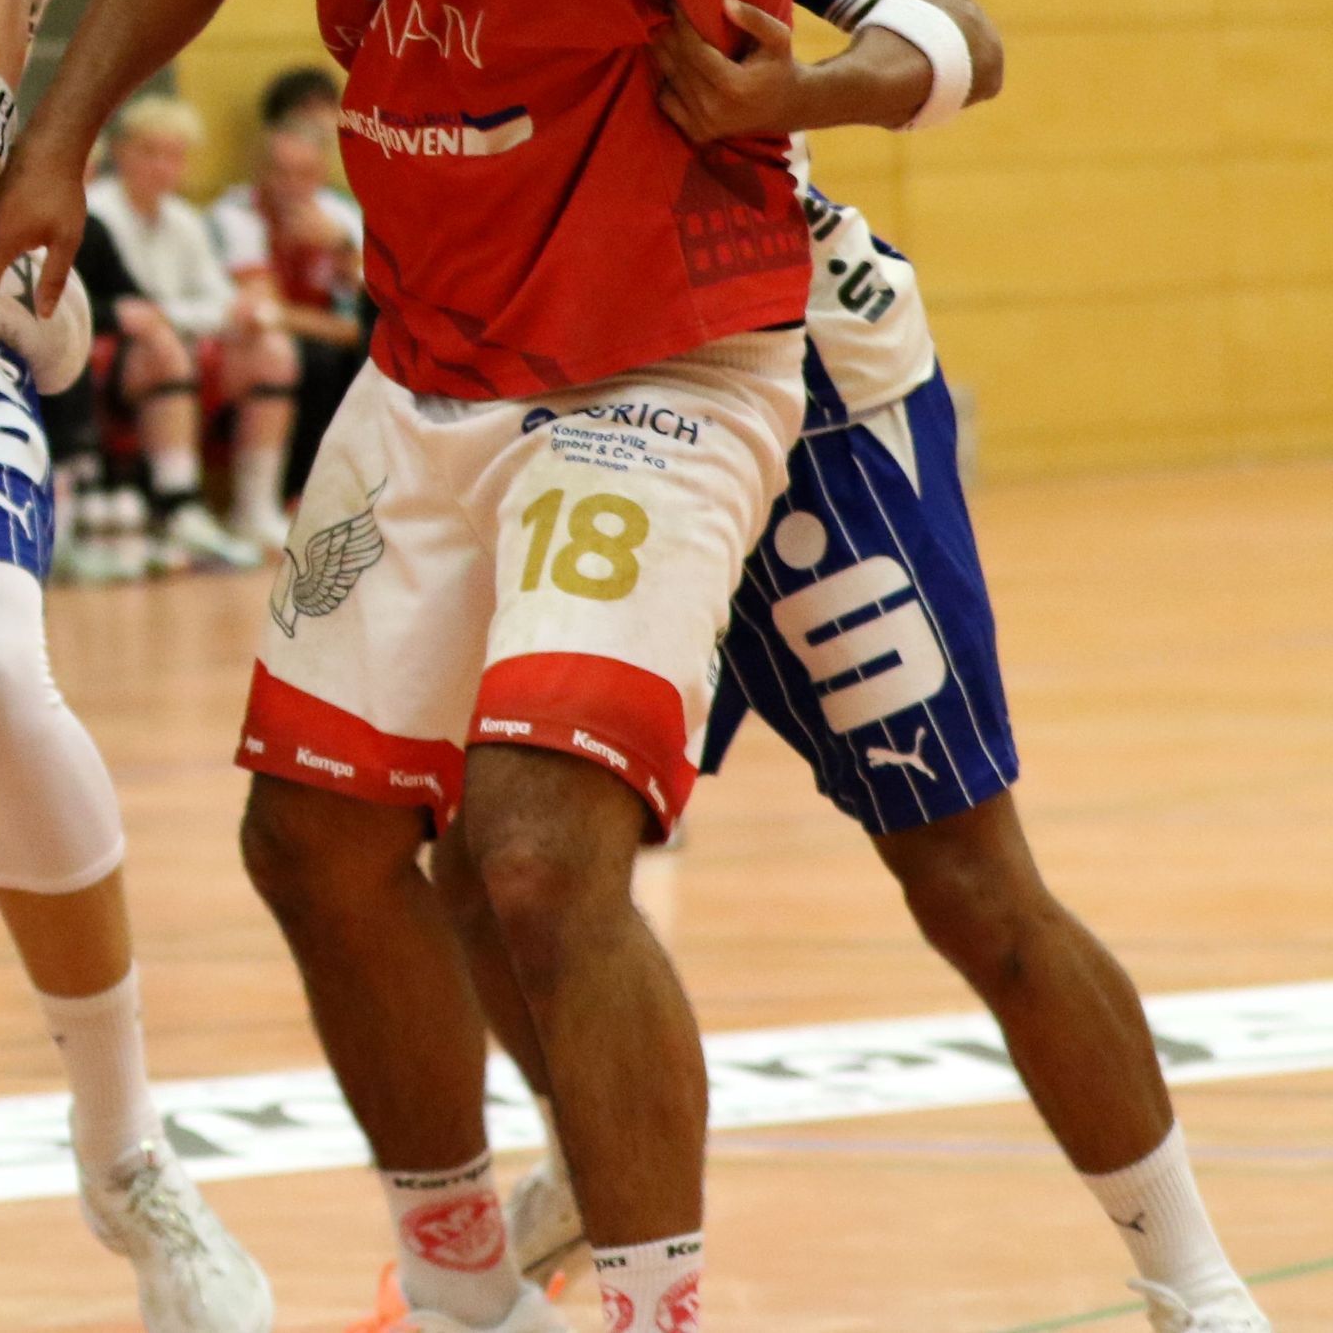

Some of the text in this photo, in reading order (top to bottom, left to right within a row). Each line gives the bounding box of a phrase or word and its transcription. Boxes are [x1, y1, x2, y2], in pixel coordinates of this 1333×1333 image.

[550, 439, 667, 470] GmbH & Co. KG
[520, 487, 650, 602] 18
[296, 747, 356, 779] Kempa
[479, 716, 532, 737] Kempa
[571, 729, 629, 771] Kempa
